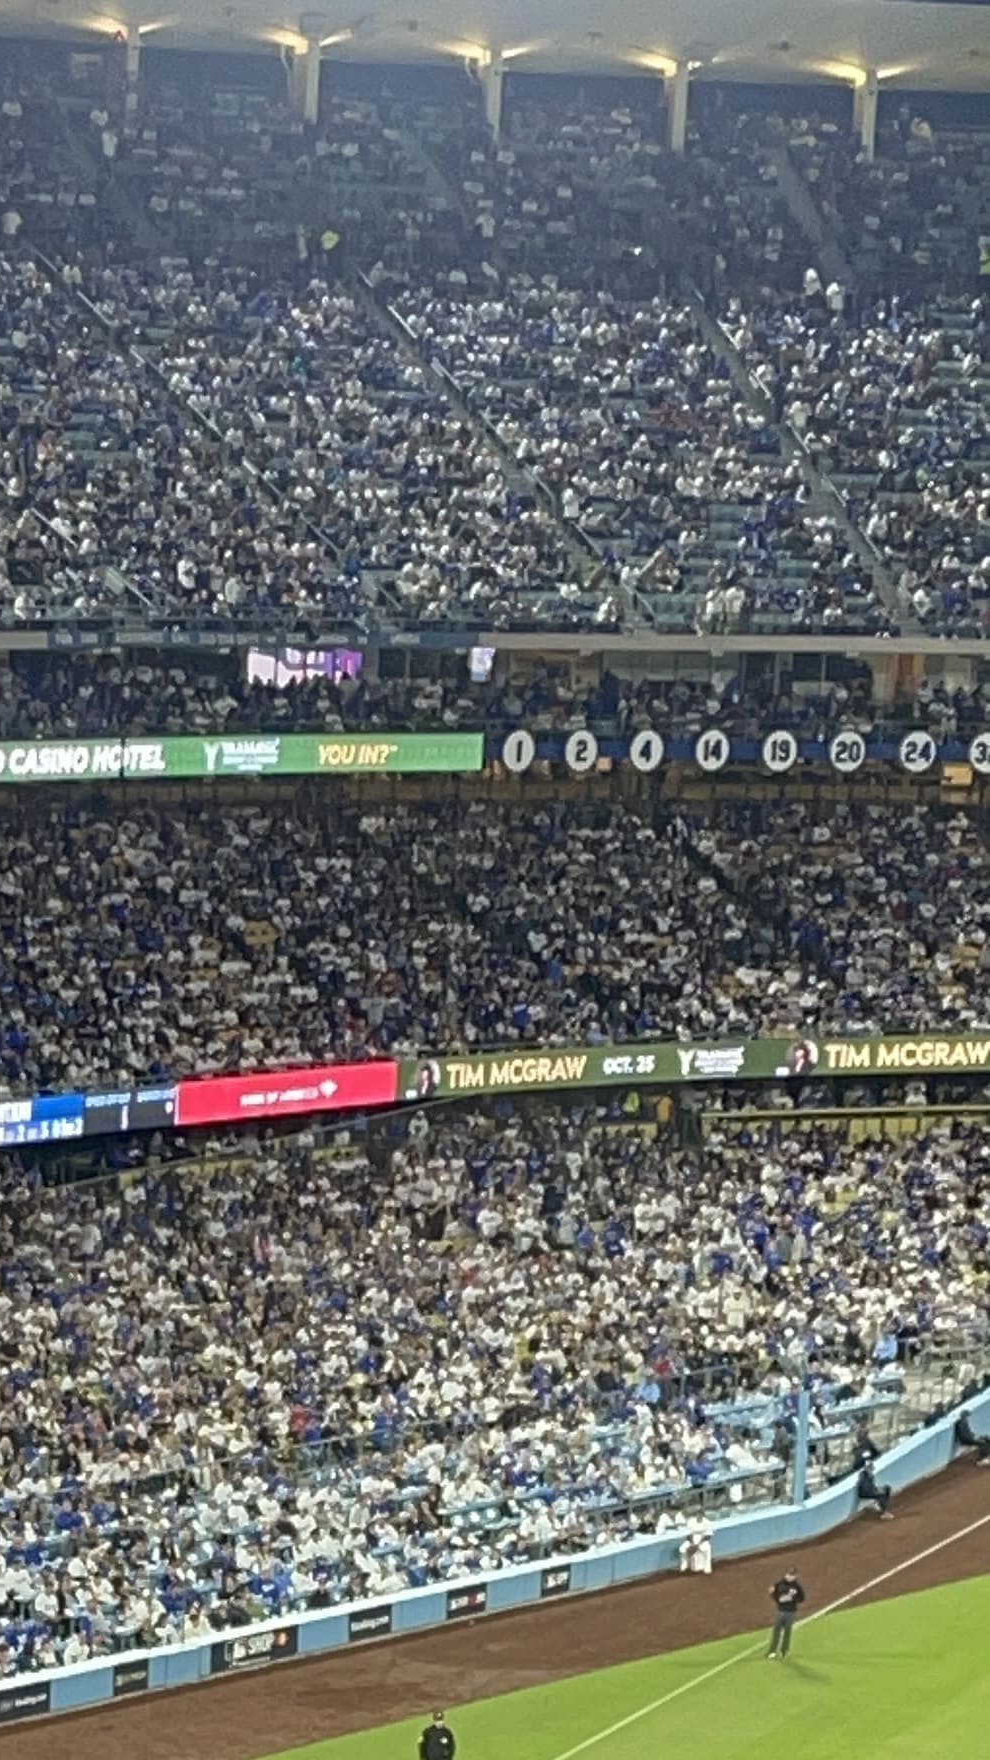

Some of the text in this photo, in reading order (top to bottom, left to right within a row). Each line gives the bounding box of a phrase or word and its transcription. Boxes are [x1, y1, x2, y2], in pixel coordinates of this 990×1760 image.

[9, 746, 89, 775] CASINO
[90, 744, 165, 772] HOTEL
[318, 744, 356, 766] YOU
[514, 740, 523, 760] 1
[574, 739, 589, 760] 2
[639, 739, 655, 760] 4
[702, 740, 722, 761] 14
[770, 740, 791, 761] 19
[835, 740, 860, 761] 20
[904, 740, 932, 761] 24
[602, 1054, 656, 1075] OCT. 25
[825, 1040, 990, 1069] TIM MCGRAW
[446, 1055, 587, 1089] TIM MCGRAW
